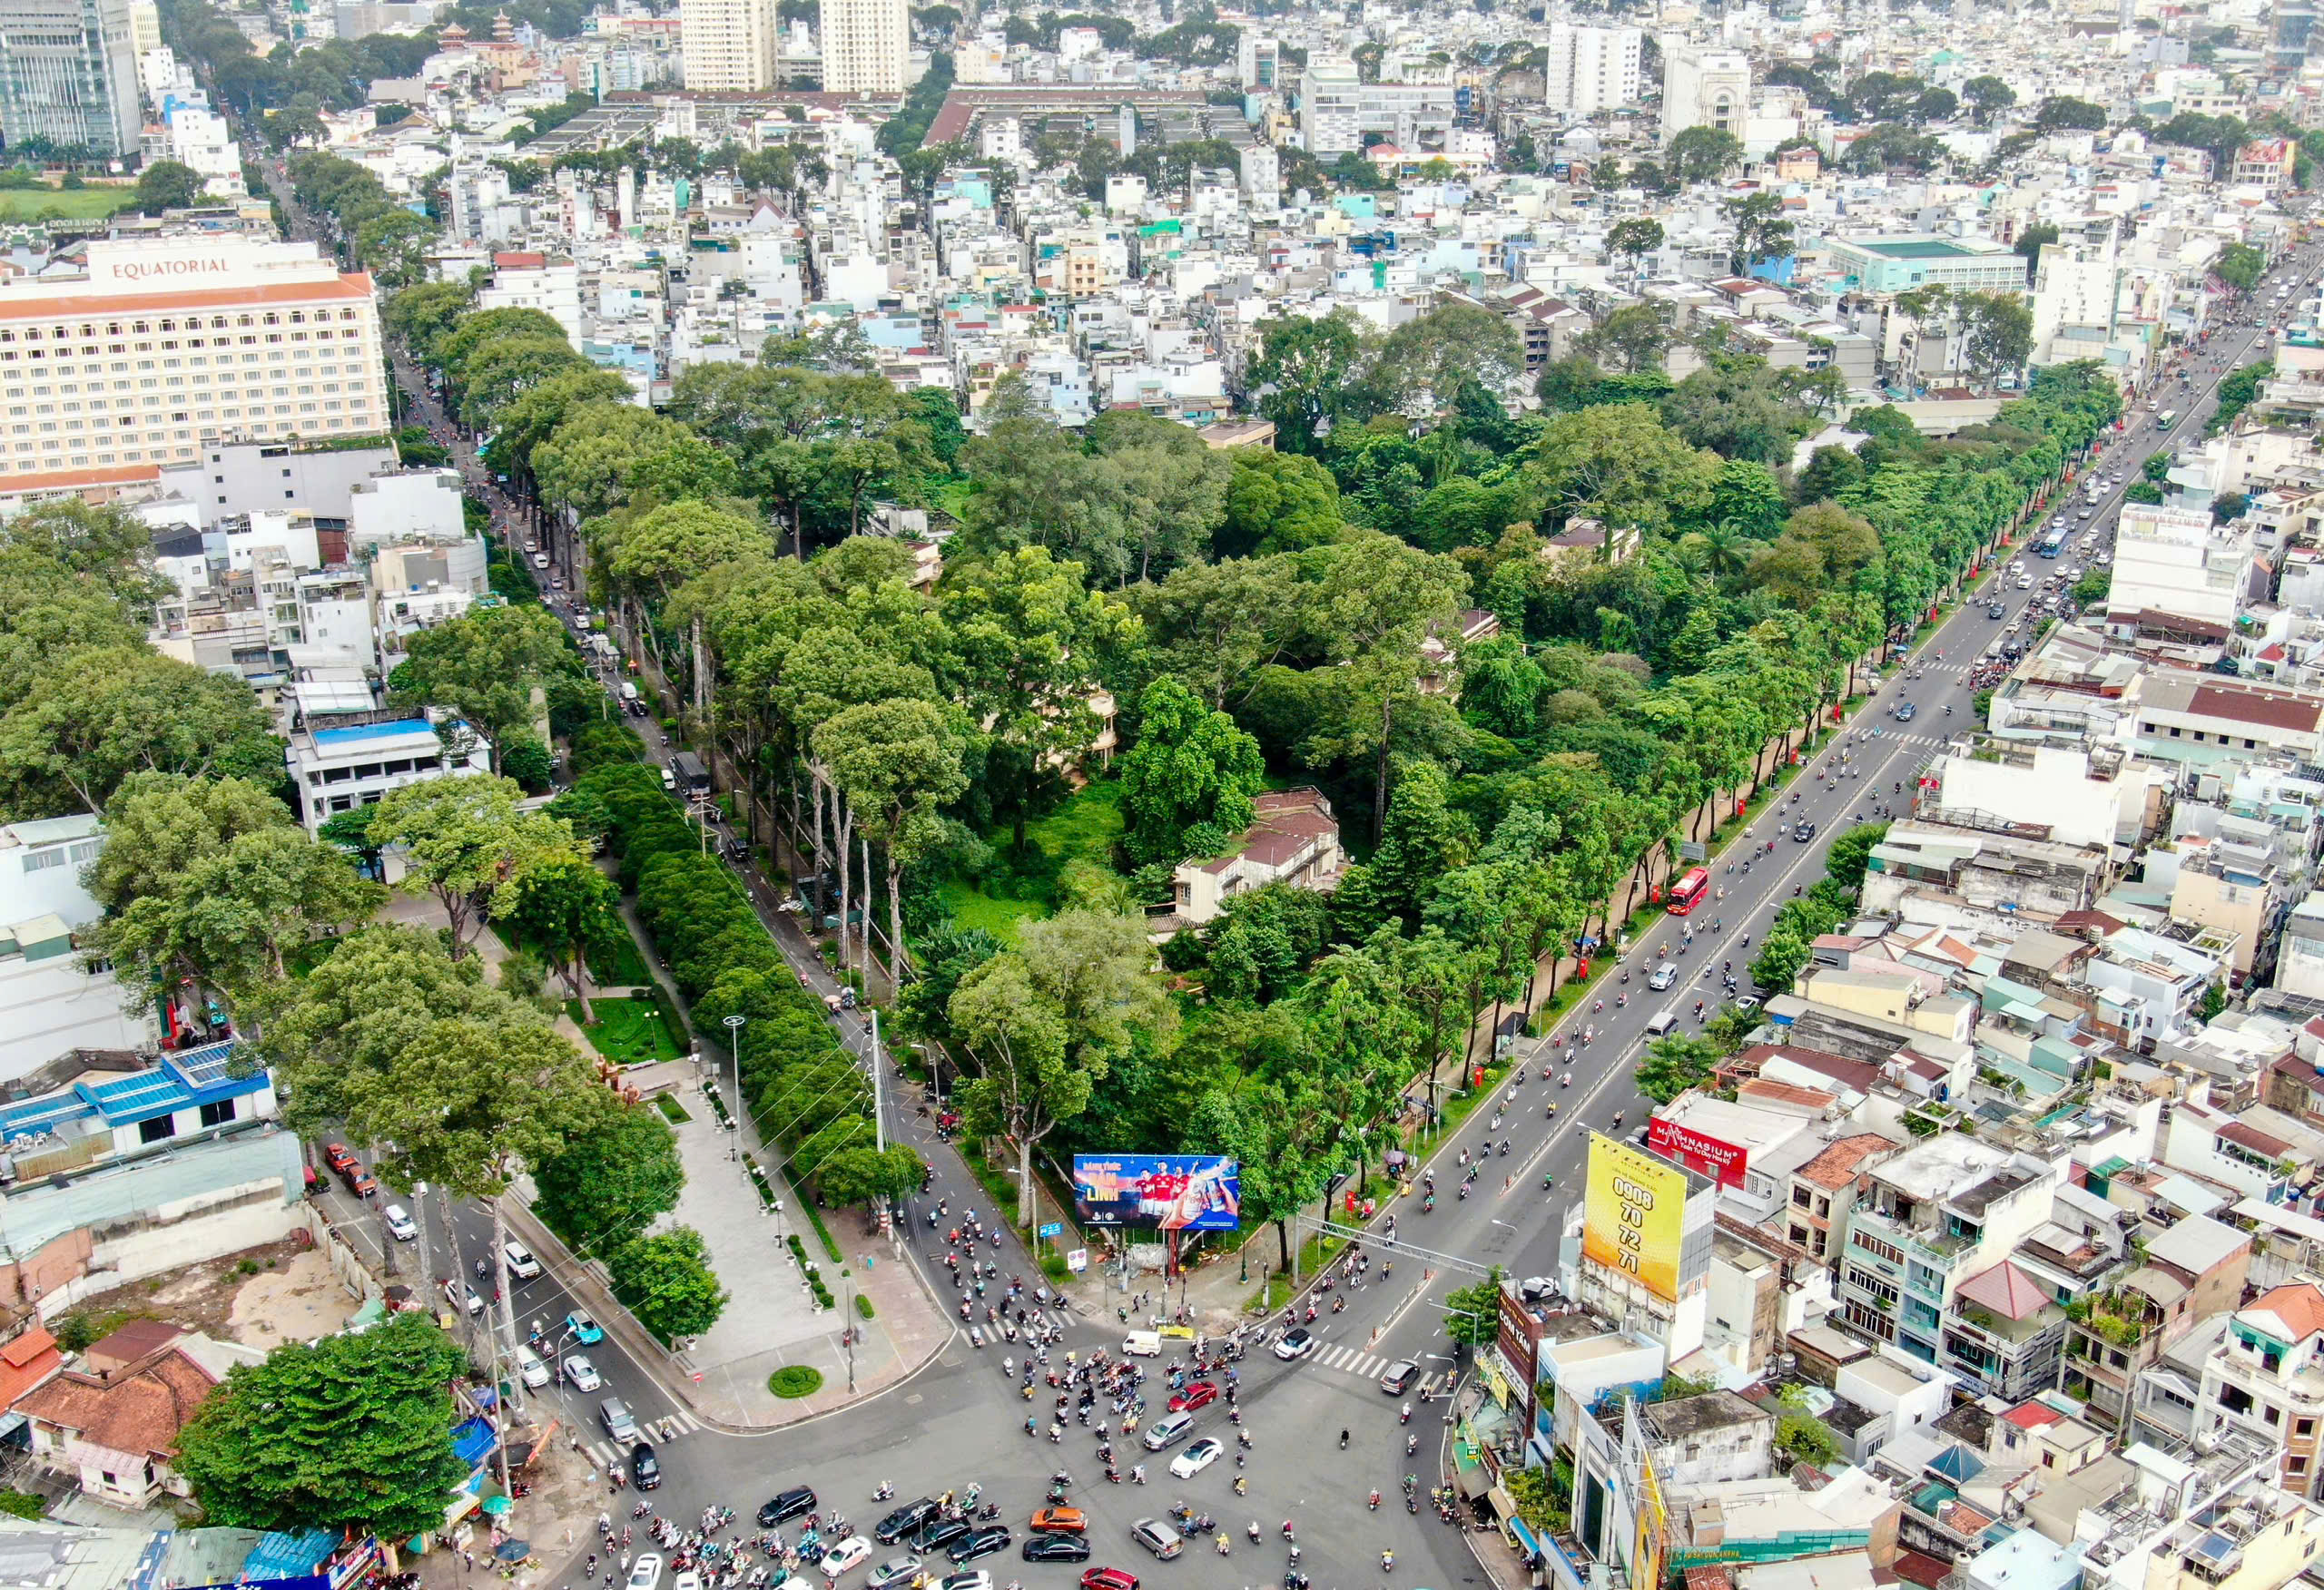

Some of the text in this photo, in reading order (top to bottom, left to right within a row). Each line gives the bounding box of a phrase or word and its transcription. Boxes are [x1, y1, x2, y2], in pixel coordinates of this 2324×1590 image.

[113, 258, 231, 280] EQUATORIAL
[1701, 1150, 1712, 1159] Duy
[1612, 1177, 1653, 1211] 0908
[1620, 1202, 1642, 1228] 70
[1618, 1224, 1641, 1251] 72
[1618, 1247, 1639, 1274] 71
[1499, 1309, 1515, 1336] CƠM
[1515, 1329, 1531, 1355] TẤM
